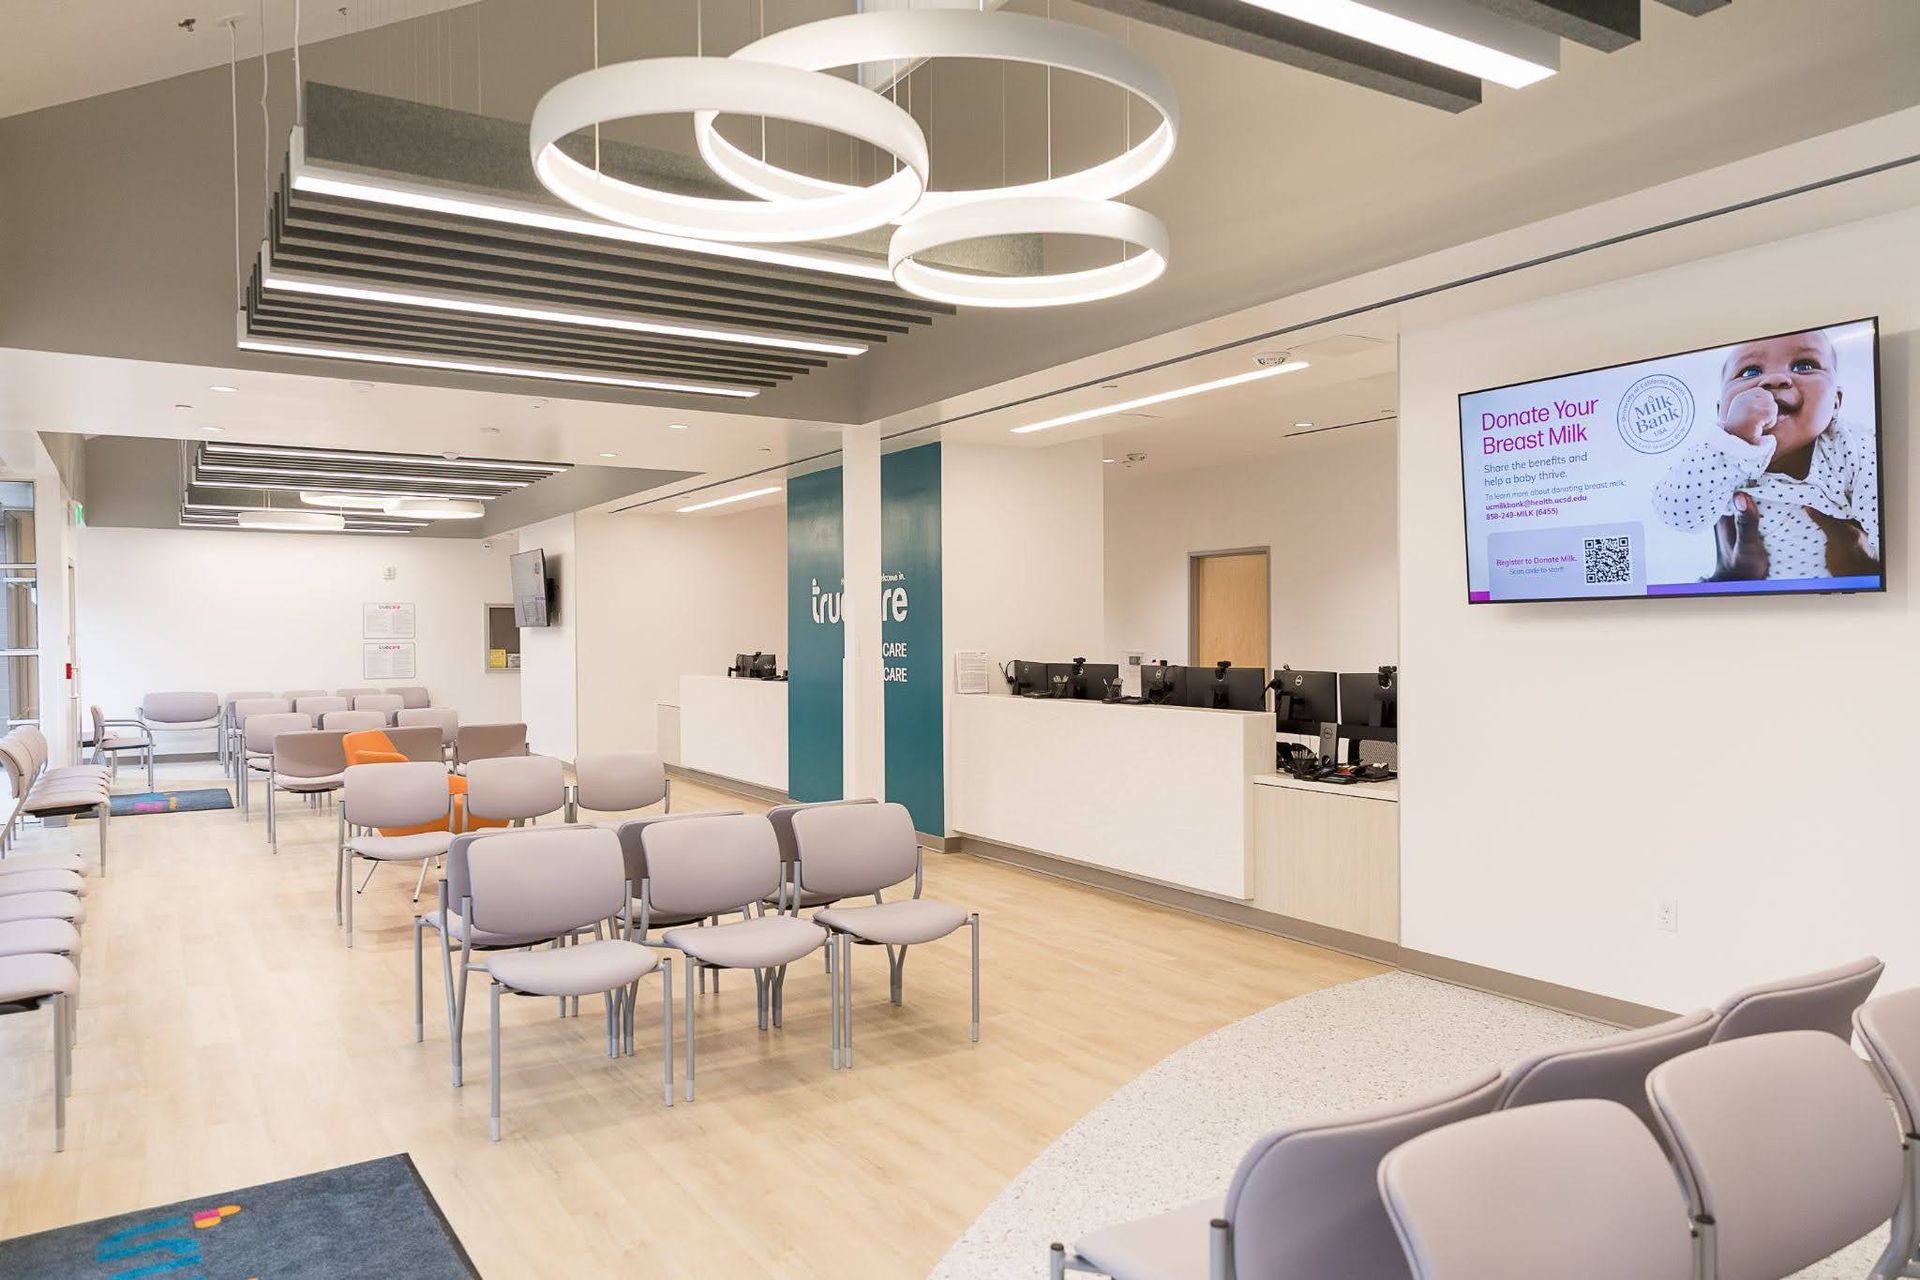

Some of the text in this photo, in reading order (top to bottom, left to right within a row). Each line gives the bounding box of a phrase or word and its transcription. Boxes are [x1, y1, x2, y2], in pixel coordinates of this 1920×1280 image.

[1482, 399, 1599, 431] Donate Your
[1634, 394, 1673, 420] Milk
[1636, 407, 1680, 434] Bank
[1483, 423, 1588, 455] Breast Milk
[1484, 452, 1588, 473] Share the benefits and
[1484, 476, 1503, 487] help
[1513, 472, 1537, 484] baby
[1538, 469, 1568, 479] thrive.
[1530, 487, 1550, 497] about
[1551, 484, 1583, 495] donating
[1584, 481, 1608, 491] breast
[1485, 494, 1588, 511] ucmilkbank@health.ucsd.edu
[1485, 507, 1559, 521] 858-249-MILK (6455)
[1496, 558, 1524, 568] Register
[1534, 556, 1560, 564] Donate
[1509, 567, 1525, 576] Scan
[882, 642, 908, 658] CARE
[883, 667, 908, 683] CARE
